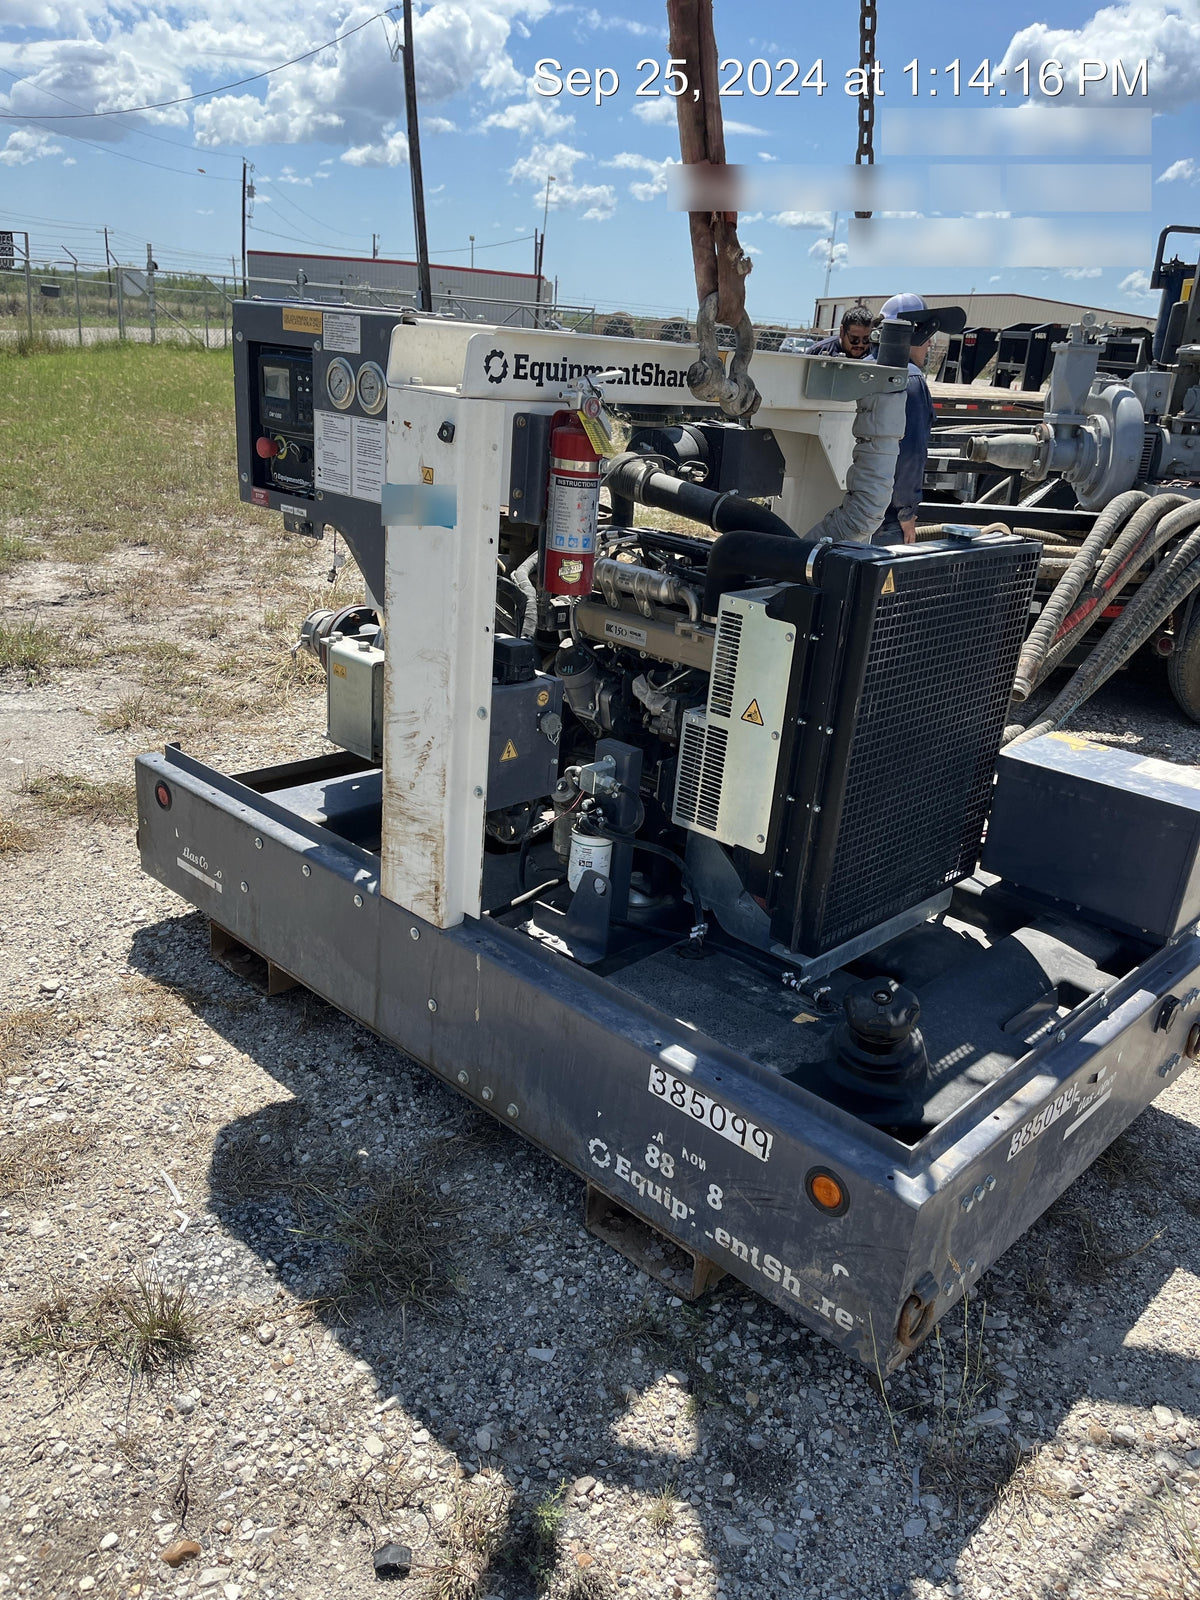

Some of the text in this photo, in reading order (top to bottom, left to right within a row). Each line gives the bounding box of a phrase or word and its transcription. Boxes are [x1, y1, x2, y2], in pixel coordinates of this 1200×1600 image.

[513, 354, 690, 388] EquipmentShar
[557, 479, 597, 488] INSTRUCTIONS
[651, 1067, 770, 1160] 385099
[1010, 1086, 1075, 1156] 385099
[614, 1153, 855, 1332] EquipentShre
